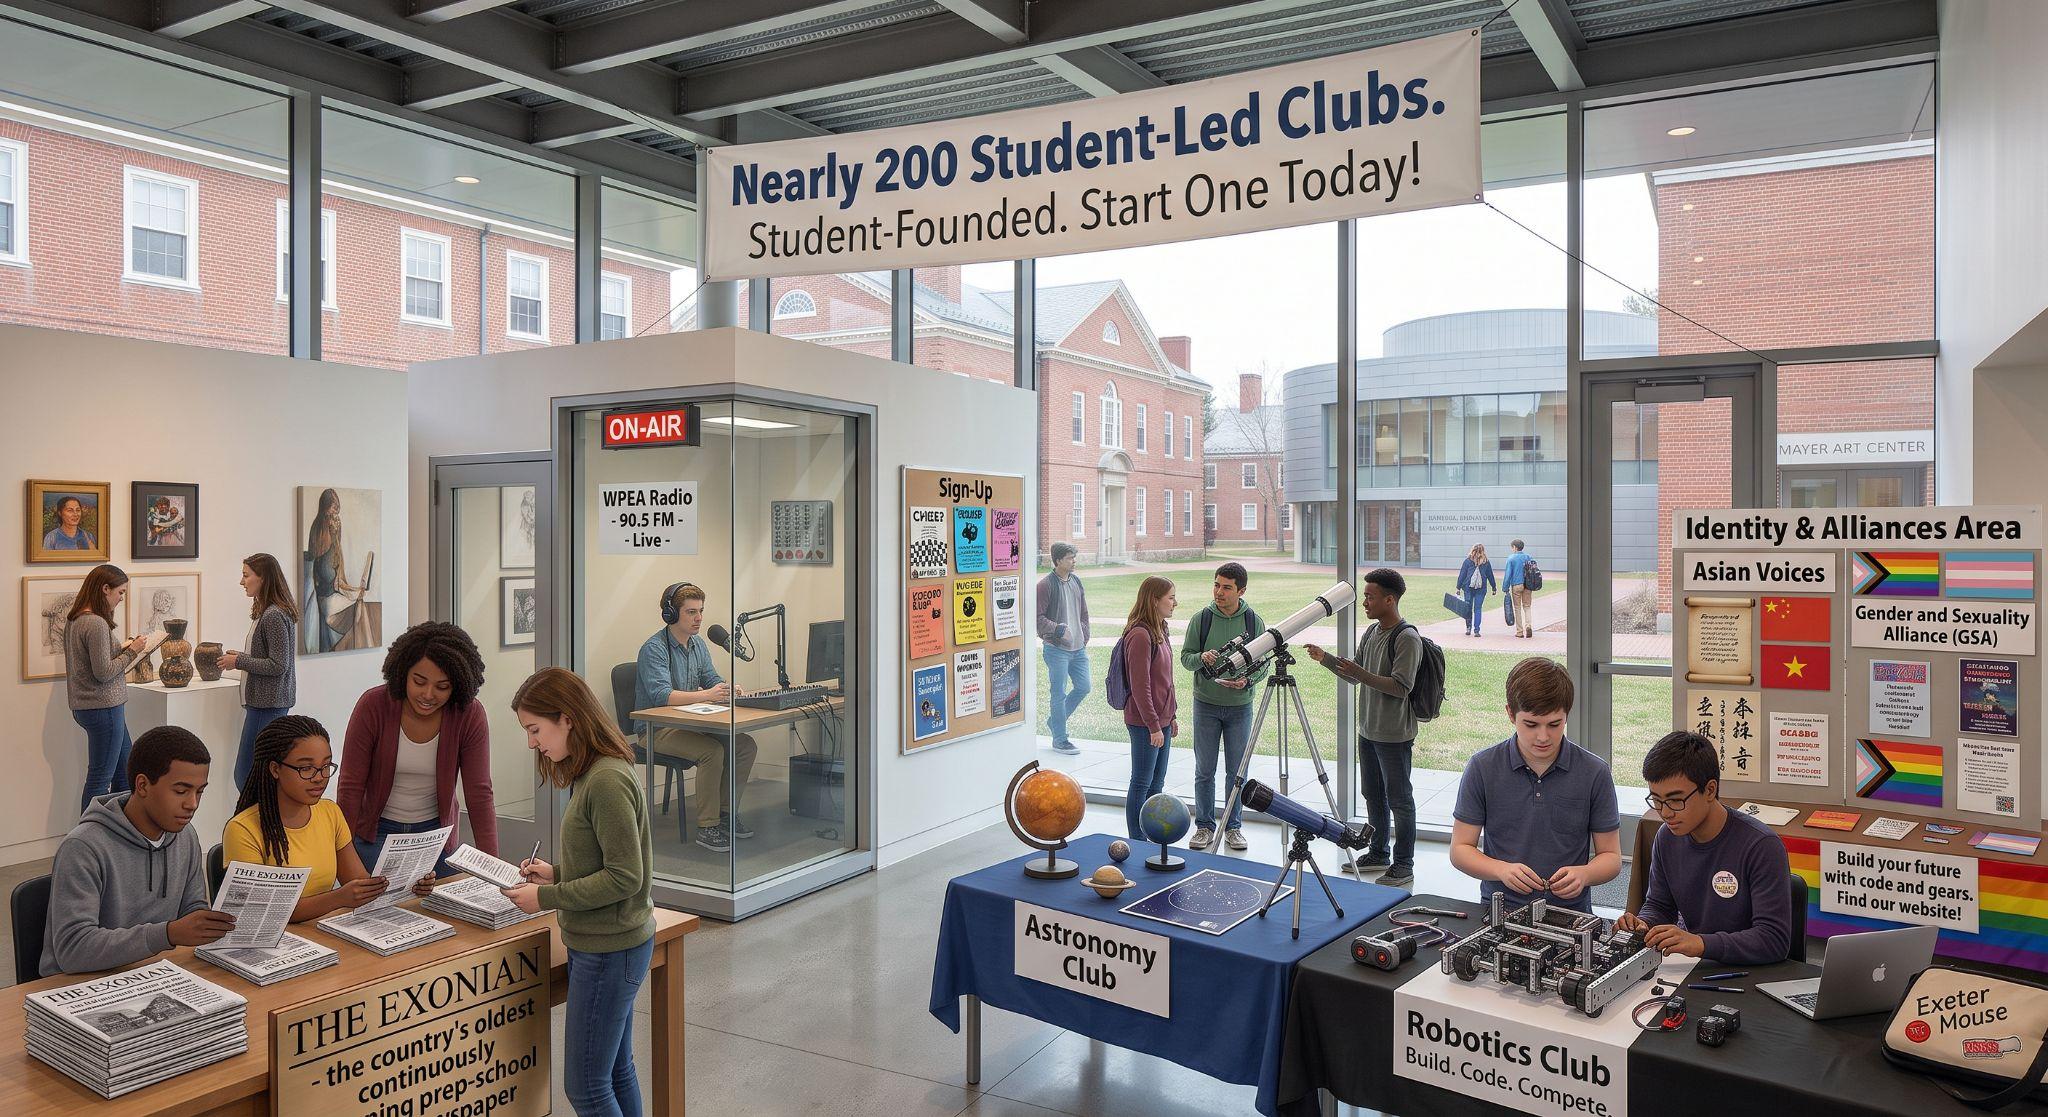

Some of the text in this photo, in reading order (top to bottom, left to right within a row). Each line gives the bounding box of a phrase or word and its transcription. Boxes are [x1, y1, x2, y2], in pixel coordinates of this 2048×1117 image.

[732, 69, 1446, 211] Nearly 200 Student-Led Clubs.
[748, 140, 1421, 260] Student-Founded. Start One Today!
[609, 415, 681, 440] ON-AIR
[1780, 441, 1925, 455] MAYER ART CENTER
[604, 488, 692, 506] WPEA Radio
[940, 478, 992, 504] Sign-Up
[620, 513, 649, 528] 90.5
[654, 512, 674, 526] FM
[1687, 515, 2021, 545] Identity & Alliances Area
[634, 532, 661, 547] Live
[1693, 562, 1825, 582] Asian Voices
[1856, 605, 2030, 629] Gender and Sexuality
[1884, 626, 1997, 647] Alliance (GSA)
[235, 868, 256, 876] THE
[1837, 851, 1961, 879] Build your future
[1825, 870, 1973, 905] with code and gears.
[1837, 891, 1962, 921] Find our website!
[1025, 914, 1156, 974] Astronomy
[42, 988, 88, 1002] THE
[88, 966, 174, 992] EXONIAN
[1063, 956, 1116, 989] Club
[288, 947, 541, 1057] THE EXONIAN
[1917, 988, 1989, 1016] Exeter
[1940, 1006, 2007, 1033] Mouse
[327, 1060, 364, 1087] the
[371, 1021, 468, 1071] country's
[475, 998, 534, 1033] oldest
[1408, 1011, 1610, 1086] Robotics Club
[359, 1040, 495, 1103] continuously
[420, 1046, 537, 1114] prep-school
[1407, 1047, 1613, 1117] Build. Code. Compete.
